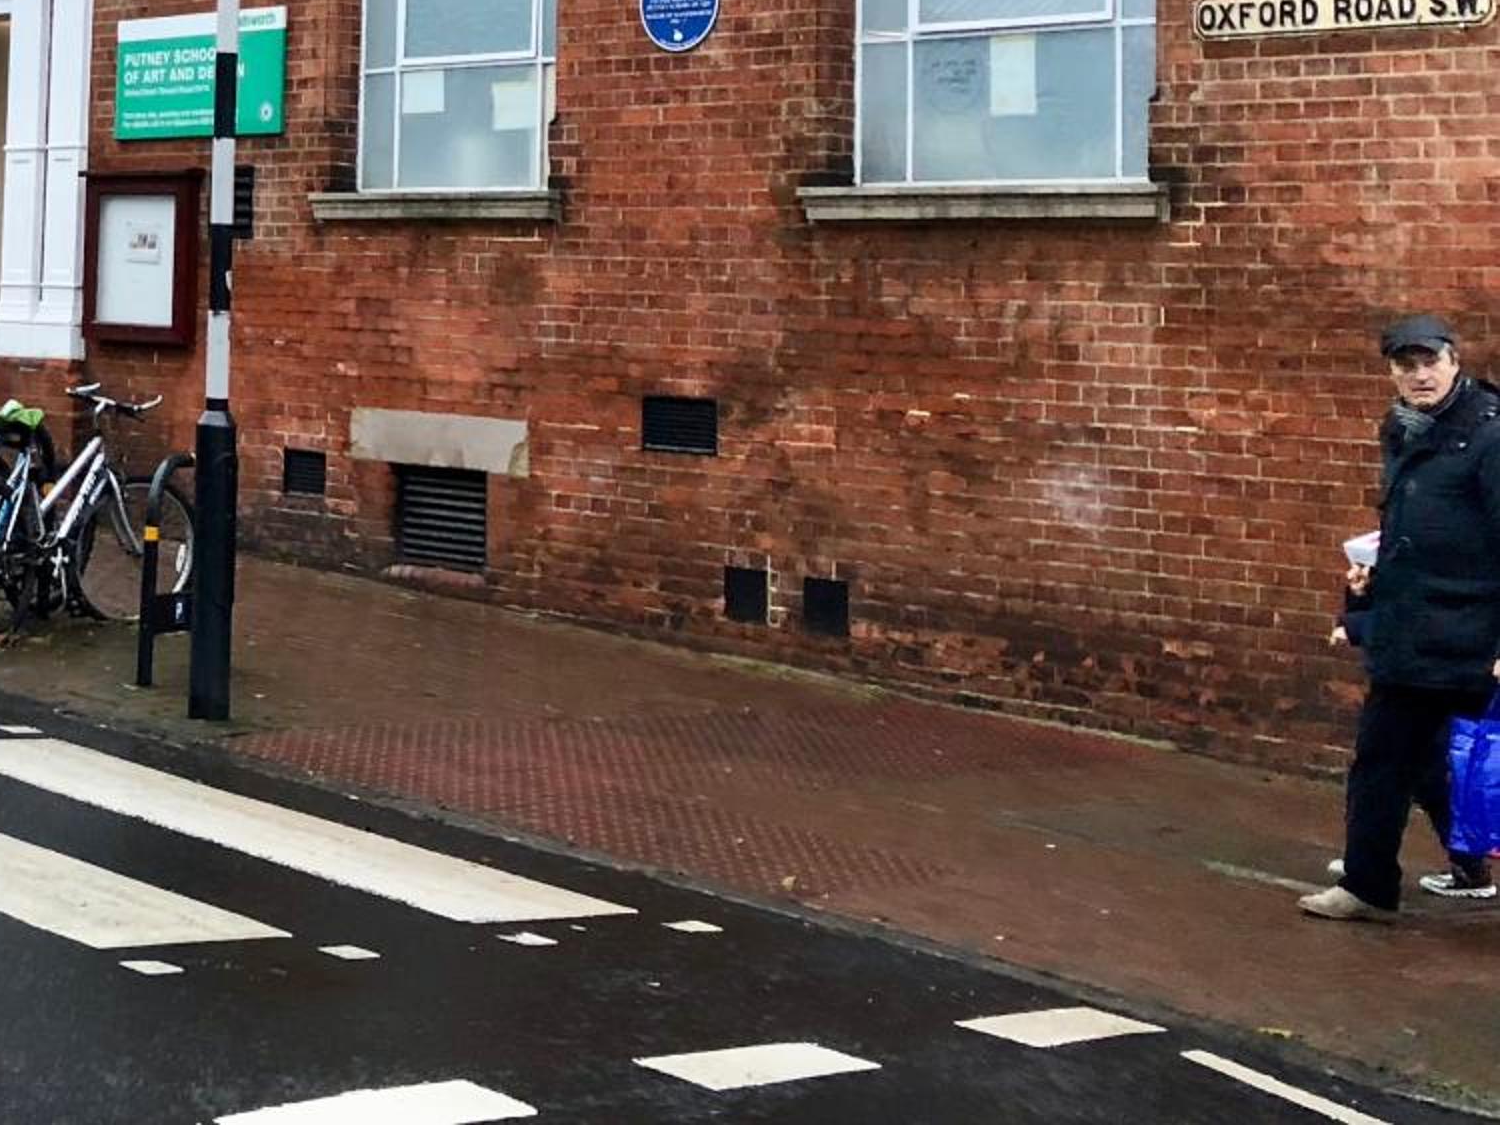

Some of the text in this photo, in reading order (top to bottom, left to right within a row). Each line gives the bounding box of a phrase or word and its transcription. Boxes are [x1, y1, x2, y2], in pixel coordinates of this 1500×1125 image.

[123, 47, 216, 67] PUTNEY SCHOO
[123, 71, 140, 85] OF
[142, 68, 167, 84] ART
[169, 66, 195, 81] AND
